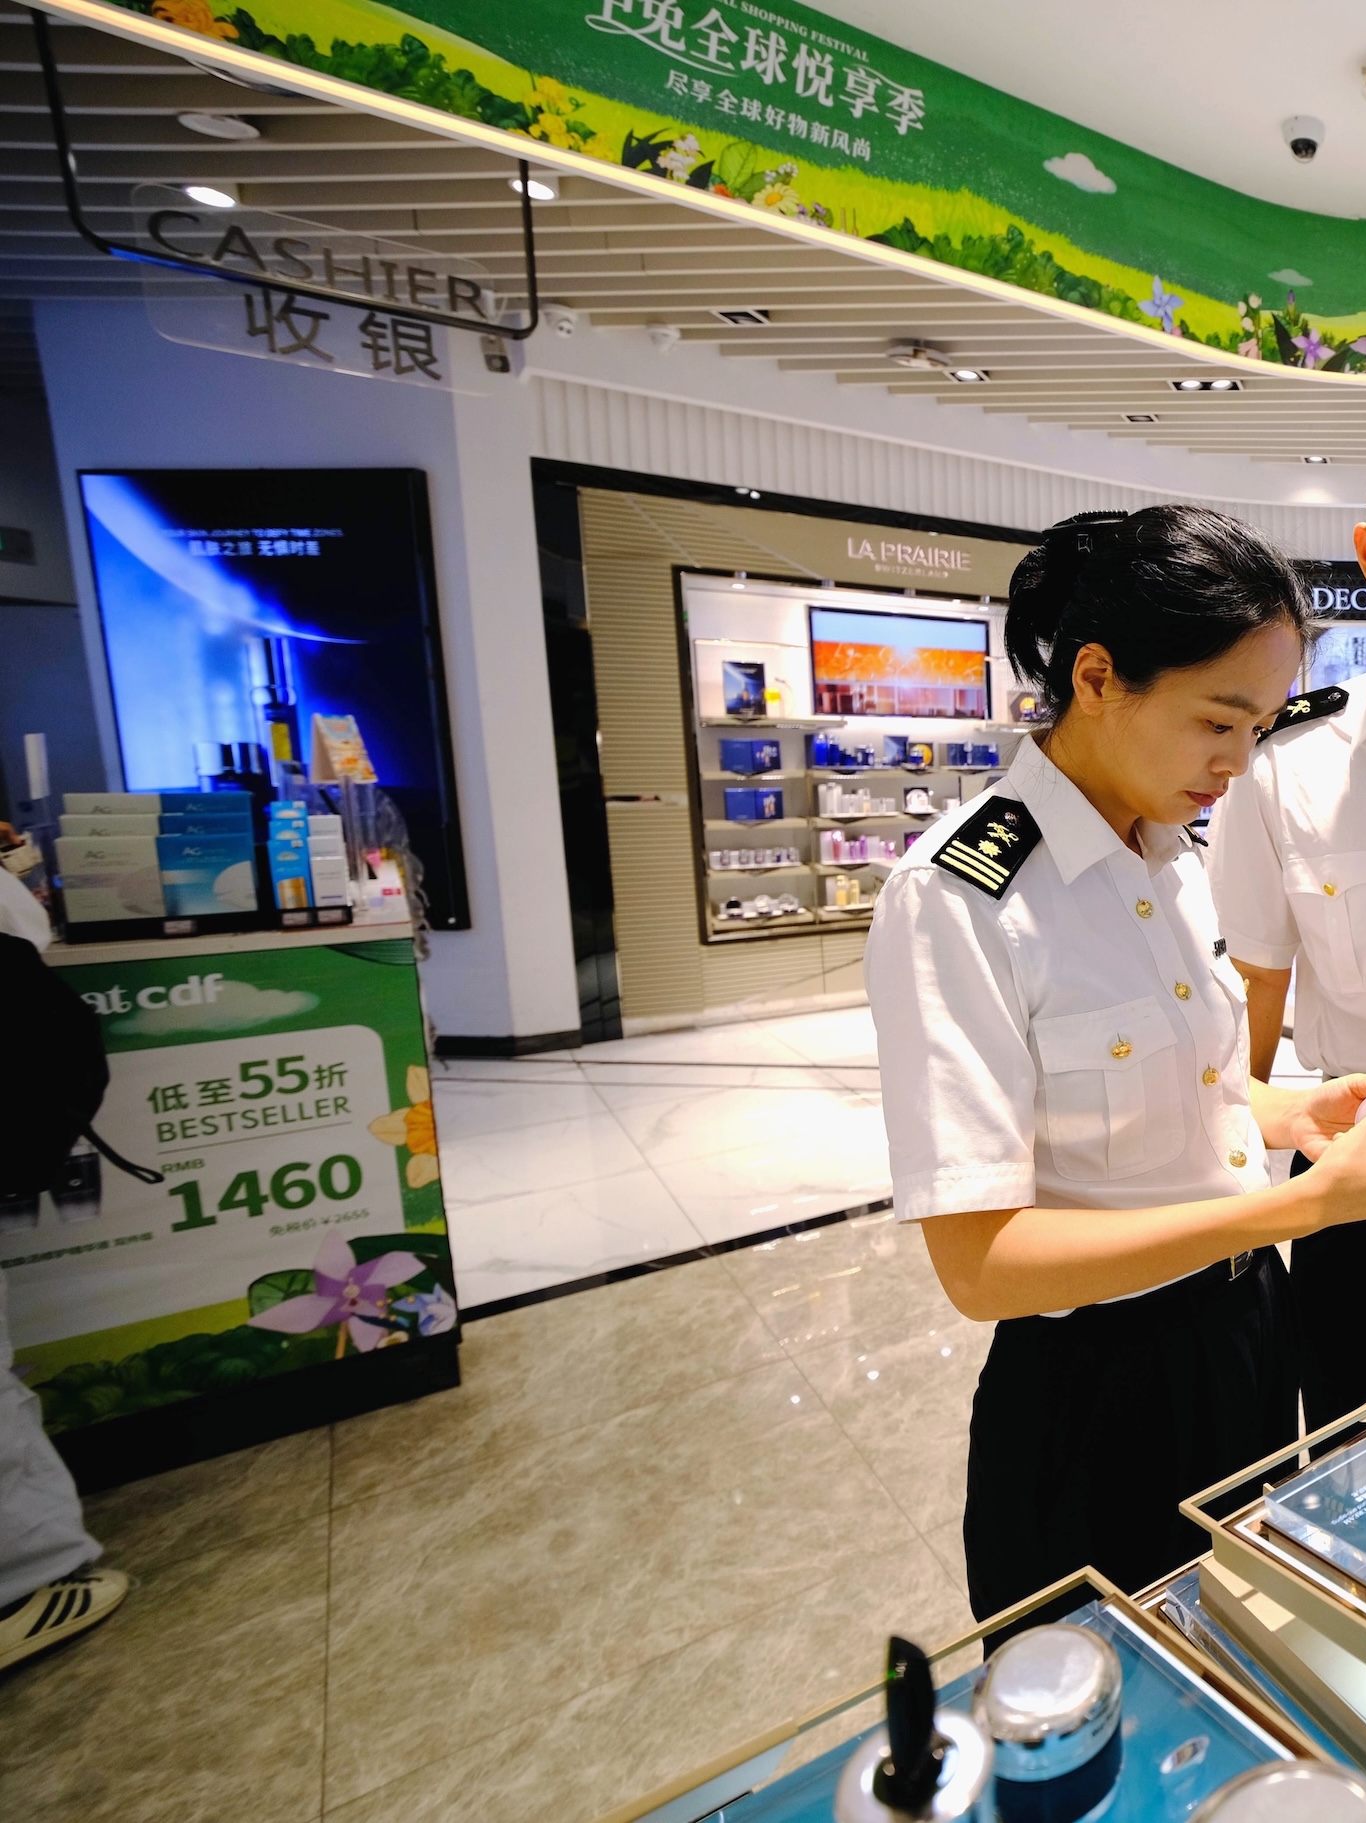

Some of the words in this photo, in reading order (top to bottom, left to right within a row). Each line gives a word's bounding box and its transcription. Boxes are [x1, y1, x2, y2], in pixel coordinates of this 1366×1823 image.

[740, 0, 808, 38] SHOPPING
[810, 25, 870, 63] FESTIVAL
[665, 69, 872, 162] 尽享全球好物新风尚
[146, 210, 487, 321] CASHIER
[243, 288, 442, 380] 收银
[847, 537, 876, 560] LA
[880, 541, 972, 571] PRAIRIE
[136, 973, 223, 1009] cdf
[147, 1055, 349, 1114] 低至55折
[156, 1096, 351, 1143] BESTSELLER
[161, 1158, 205, 1175] RMB
[167, 1154, 363, 1233] 1460
